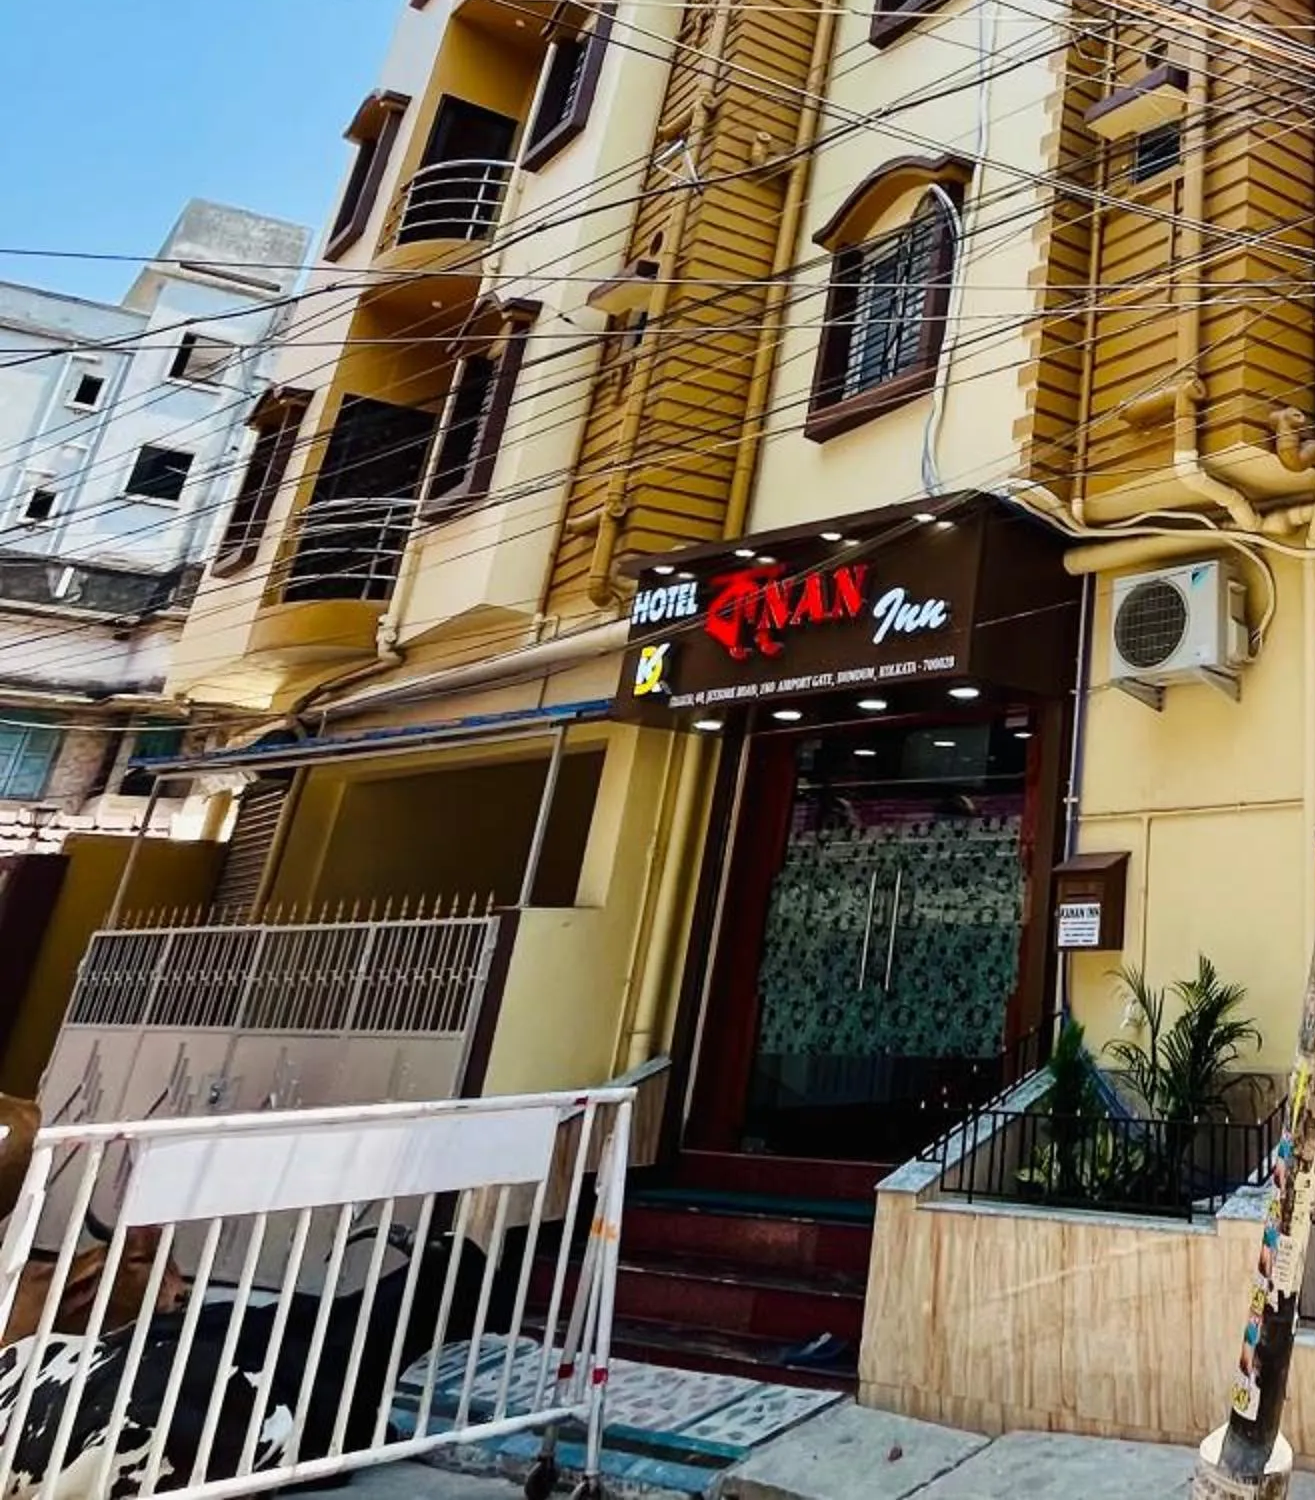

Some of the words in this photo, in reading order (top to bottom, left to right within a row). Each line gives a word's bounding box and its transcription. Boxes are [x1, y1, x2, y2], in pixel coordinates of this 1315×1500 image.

[631, 582, 699, 625] HOTEL
[873, 587, 948, 644] Inn
[776, 676, 812, 692] AIRPORT
[879, 661, 917, 678] KOLKATA
